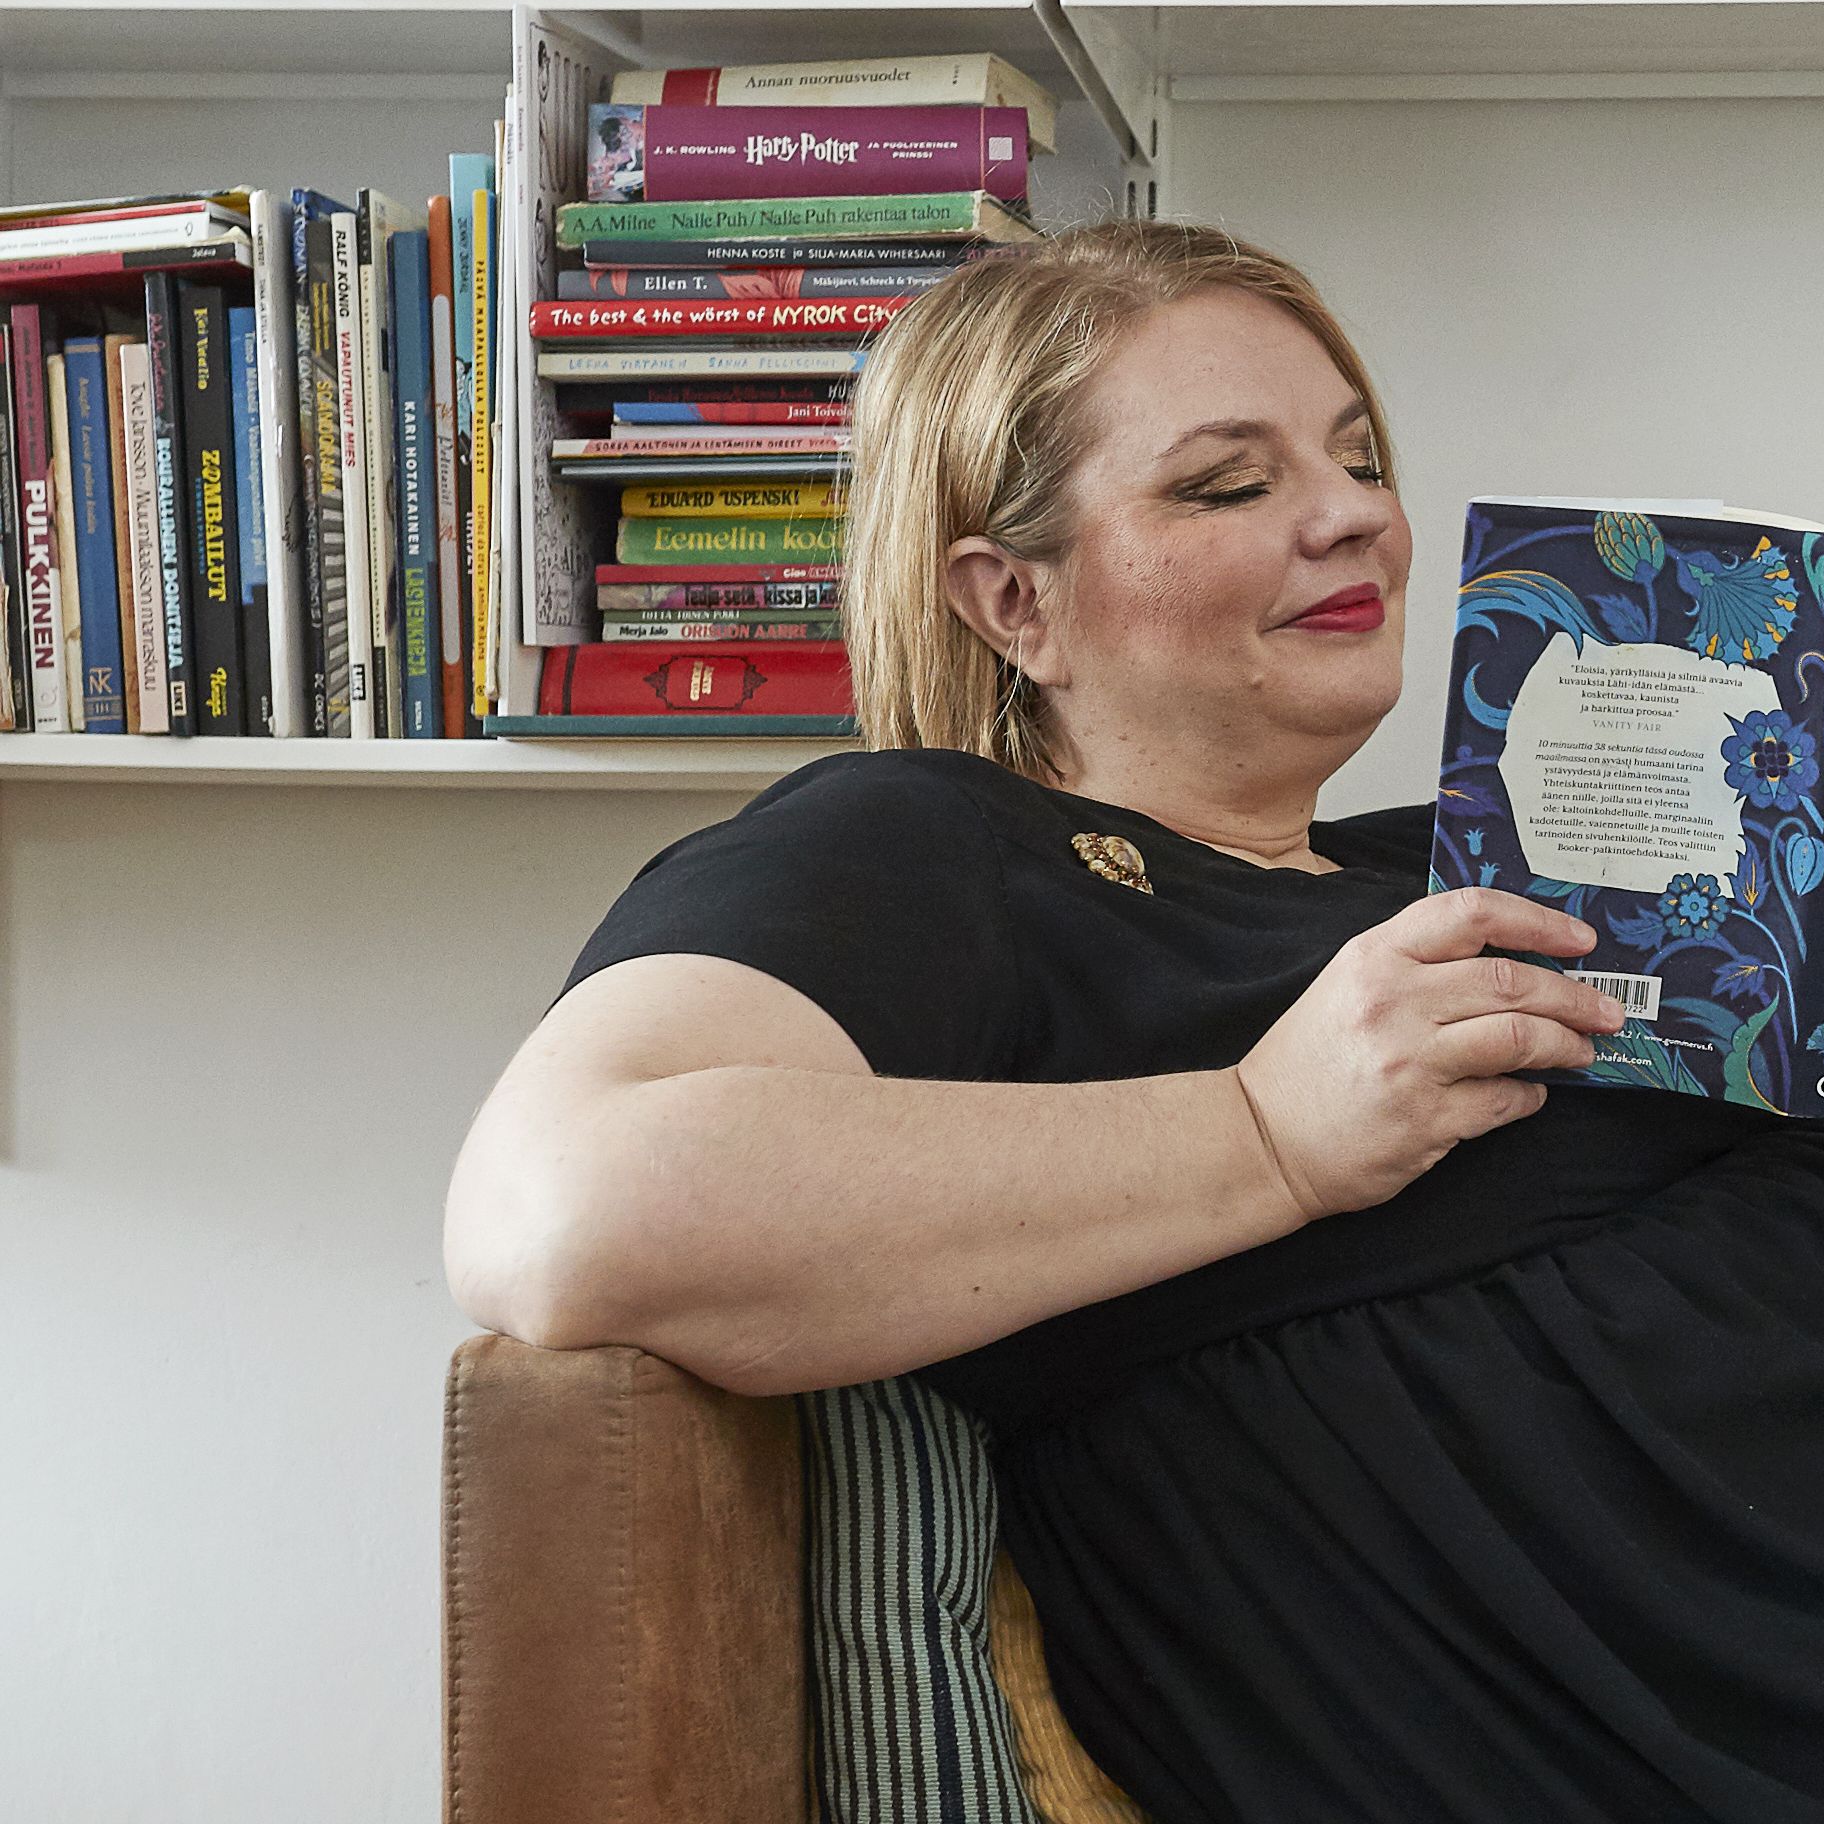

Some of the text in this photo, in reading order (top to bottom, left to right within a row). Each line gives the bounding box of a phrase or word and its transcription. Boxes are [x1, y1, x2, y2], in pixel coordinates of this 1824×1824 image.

[654, 133, 859, 165] J. K. ROWLING Harry Potter
[551, 303, 898, 326] The best & the wörst of NYROK City
[24, 479, 56, 670] PULKKINEN
[1593, 720, 1661, 732] VANITY FAIR
[1594, 743, 1605, 751] 38
